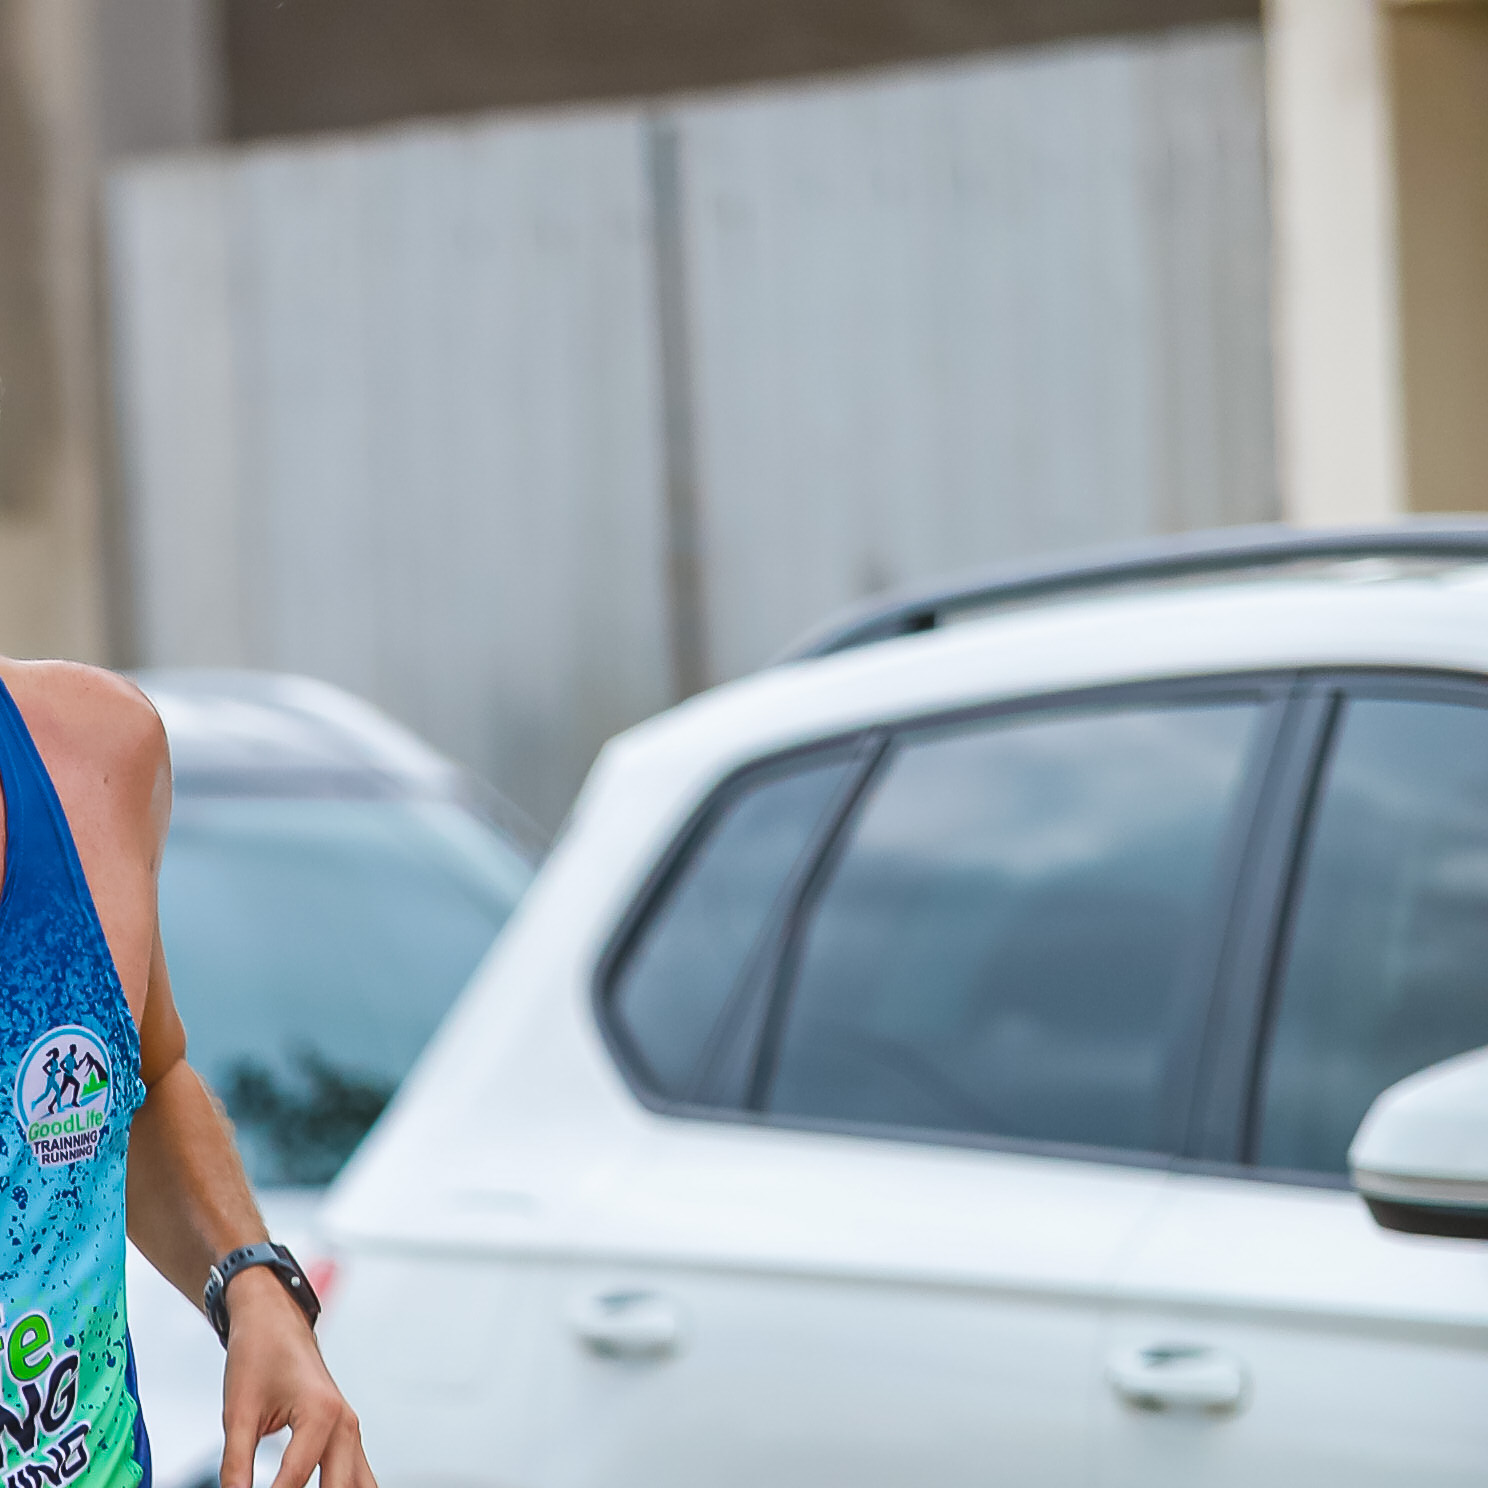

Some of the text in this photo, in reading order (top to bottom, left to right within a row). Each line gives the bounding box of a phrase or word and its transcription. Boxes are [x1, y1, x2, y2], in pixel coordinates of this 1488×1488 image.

[28, 1109, 104, 1141] GoodLife
[33, 1129, 98, 1154] TRAINNING
[41, 1145, 93, 1165] RUNNING
